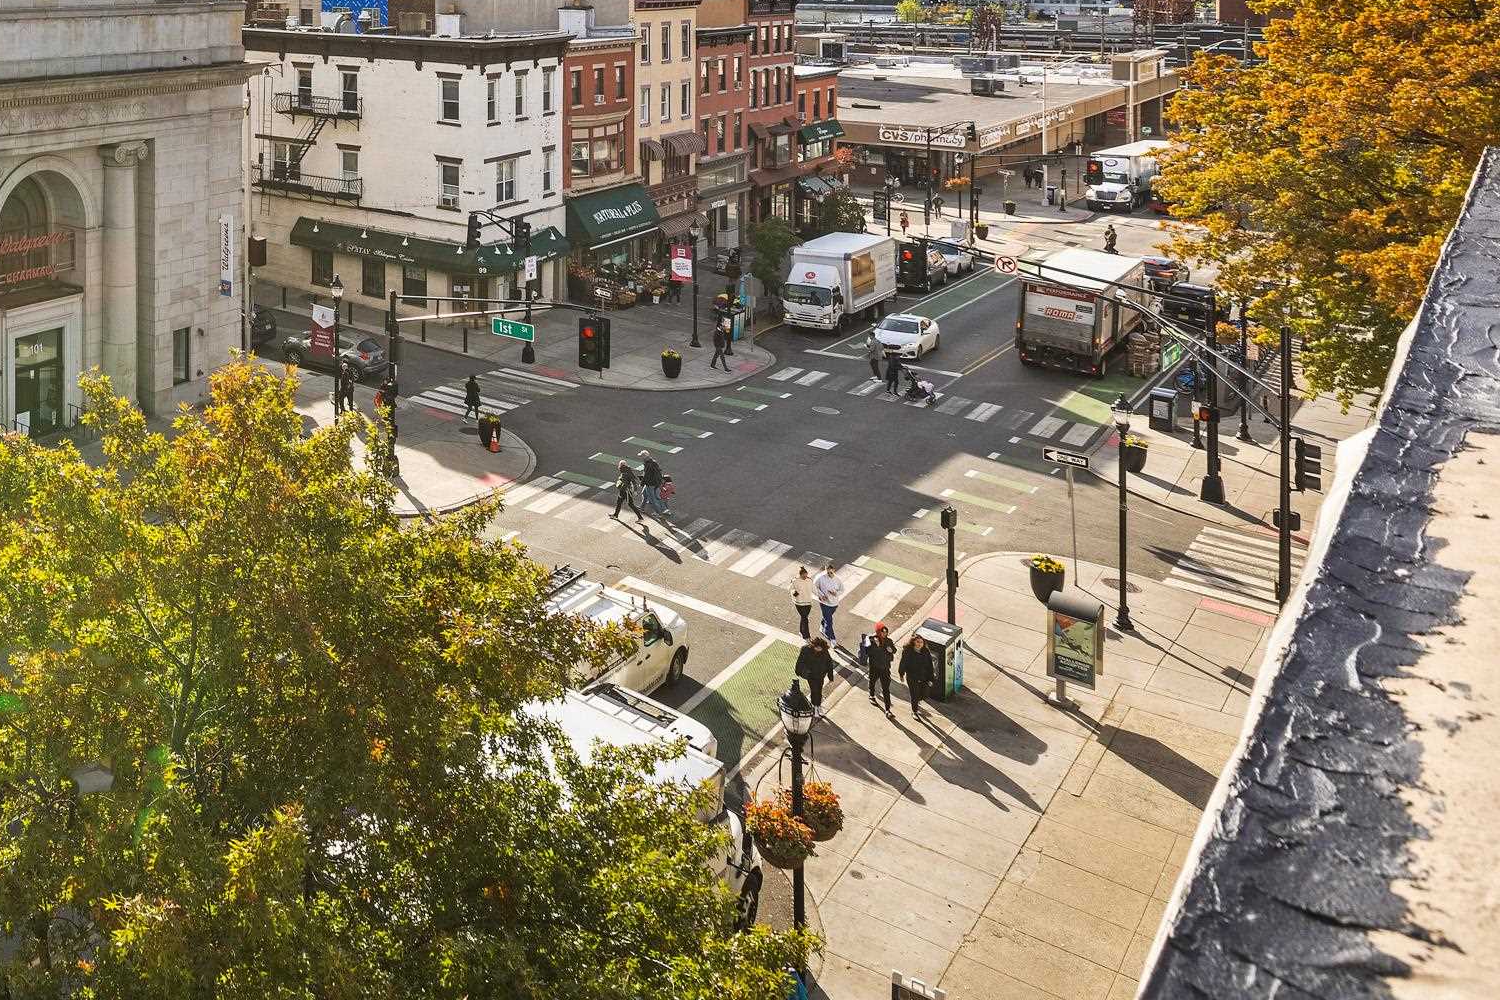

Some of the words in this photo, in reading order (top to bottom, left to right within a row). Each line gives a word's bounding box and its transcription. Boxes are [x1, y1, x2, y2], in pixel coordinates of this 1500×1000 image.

[220, 222, 231, 271] Walgreens
[5, 263, 56, 284] PHARMACY
[1046, 308, 1074, 319] ROMA
[29, 343, 43, 356] 101
